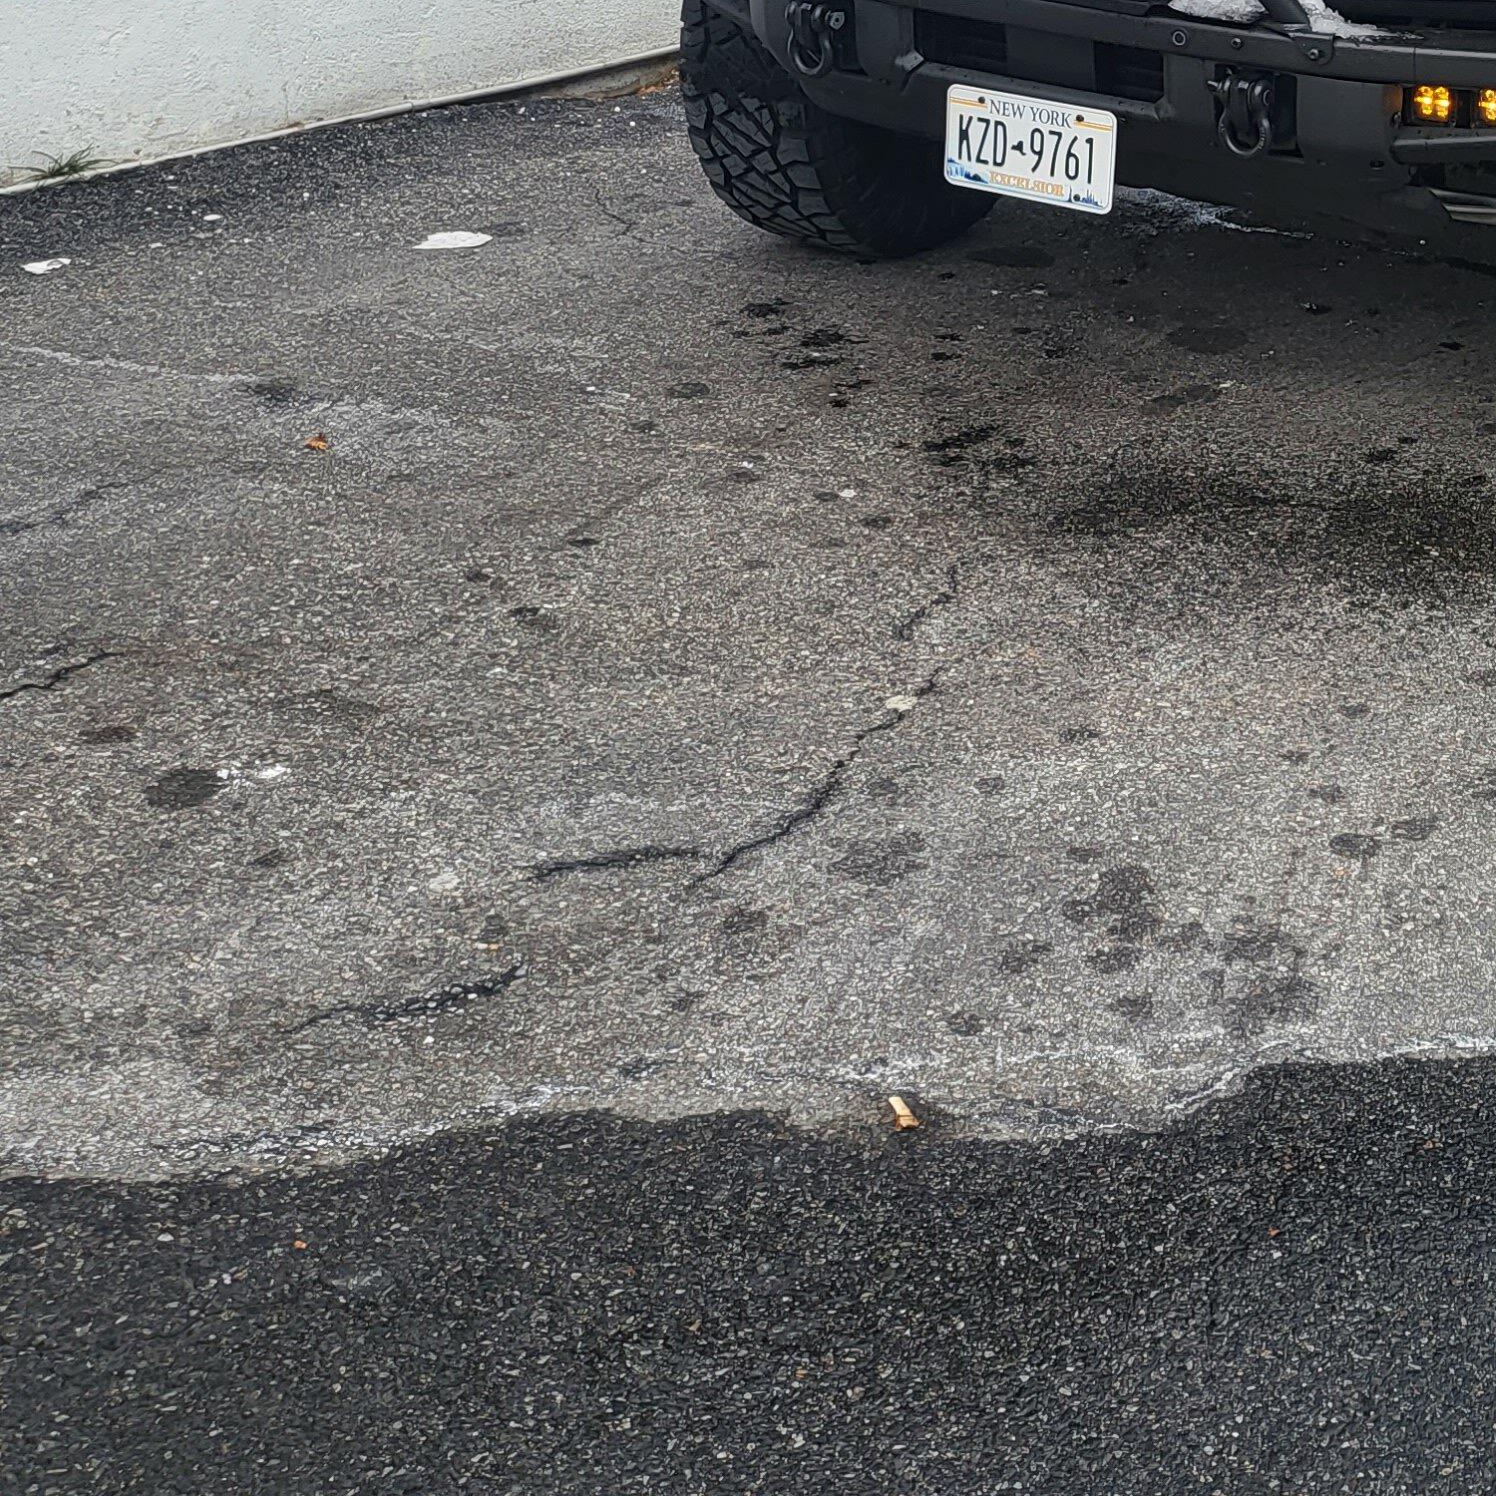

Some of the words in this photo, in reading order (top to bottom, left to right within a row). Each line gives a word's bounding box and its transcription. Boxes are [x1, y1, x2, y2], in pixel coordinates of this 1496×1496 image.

[989, 99, 1026, 120] NEW
[1030, 106, 1073, 129] YORK
[957, 114, 1008, 167] KZD
[1029, 127, 1094, 184] 9761
